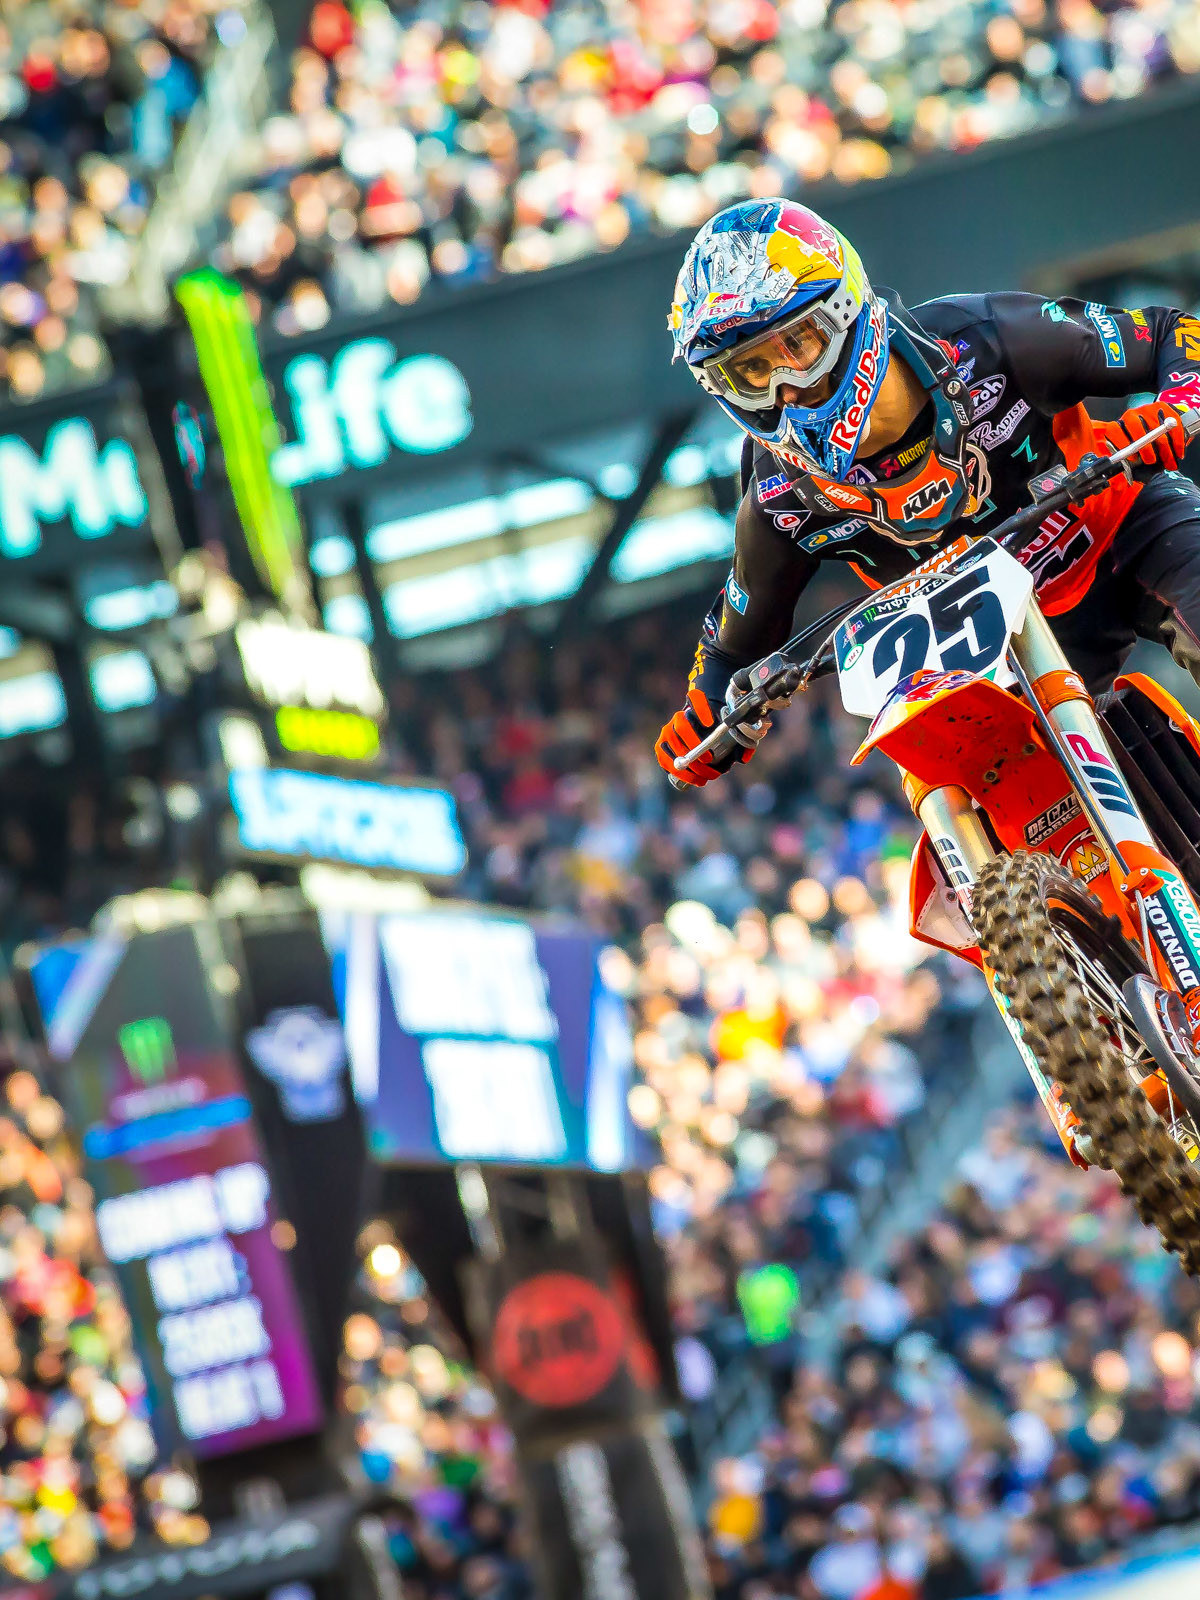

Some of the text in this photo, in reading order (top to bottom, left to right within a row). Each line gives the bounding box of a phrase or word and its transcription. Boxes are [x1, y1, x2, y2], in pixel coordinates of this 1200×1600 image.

[806, 412, 818, 422] 25
[828, 371, 876, 455] Red
[814, 493, 841, 512] LEATT
[824, 485, 863, 505] LEATT
[902, 479, 954, 523] KTM
[872, 565, 1007, 684] 25
